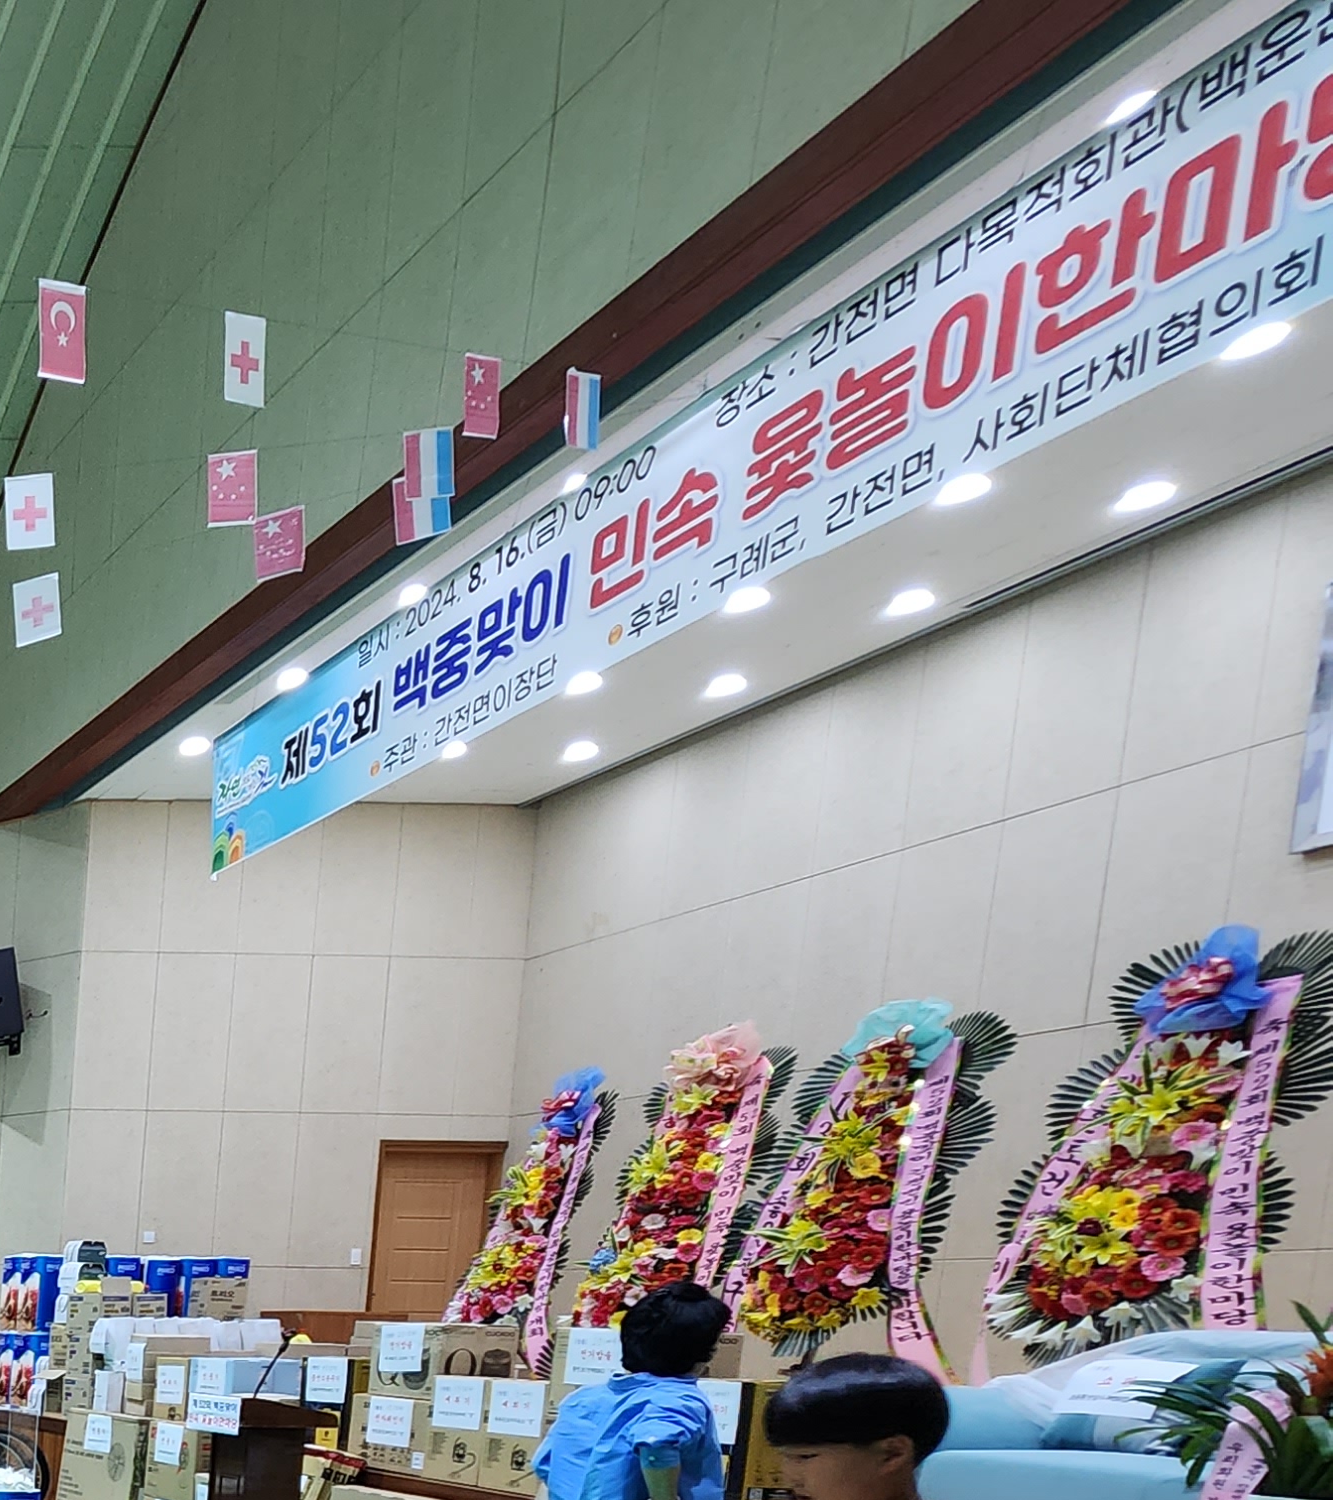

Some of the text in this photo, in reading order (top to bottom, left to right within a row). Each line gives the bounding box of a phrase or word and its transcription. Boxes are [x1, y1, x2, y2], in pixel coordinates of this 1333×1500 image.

[358, 626, 390, 667] 일시
[404, 579, 461, 637] 2024.
[468, 560, 488, 594] 8.
[574, 445, 657, 522] 09:00
[716, 364, 777, 428] 장소
[809, 261, 919, 368] 간전면
[626, 582, 682, 639] 후원
[709, 515, 807, 594] 구례군,
[825, 442, 945, 536] 간전면,
[962, 235, 1325, 463] 사회단체협의회
[280, 680, 383, 785] 제52회
[393, 551, 571, 714] 백중맞이
[589, 467, 719, 610] 민속
[383, 735, 419, 774] 주관
[434, 653, 558, 748] 간전면이장단
